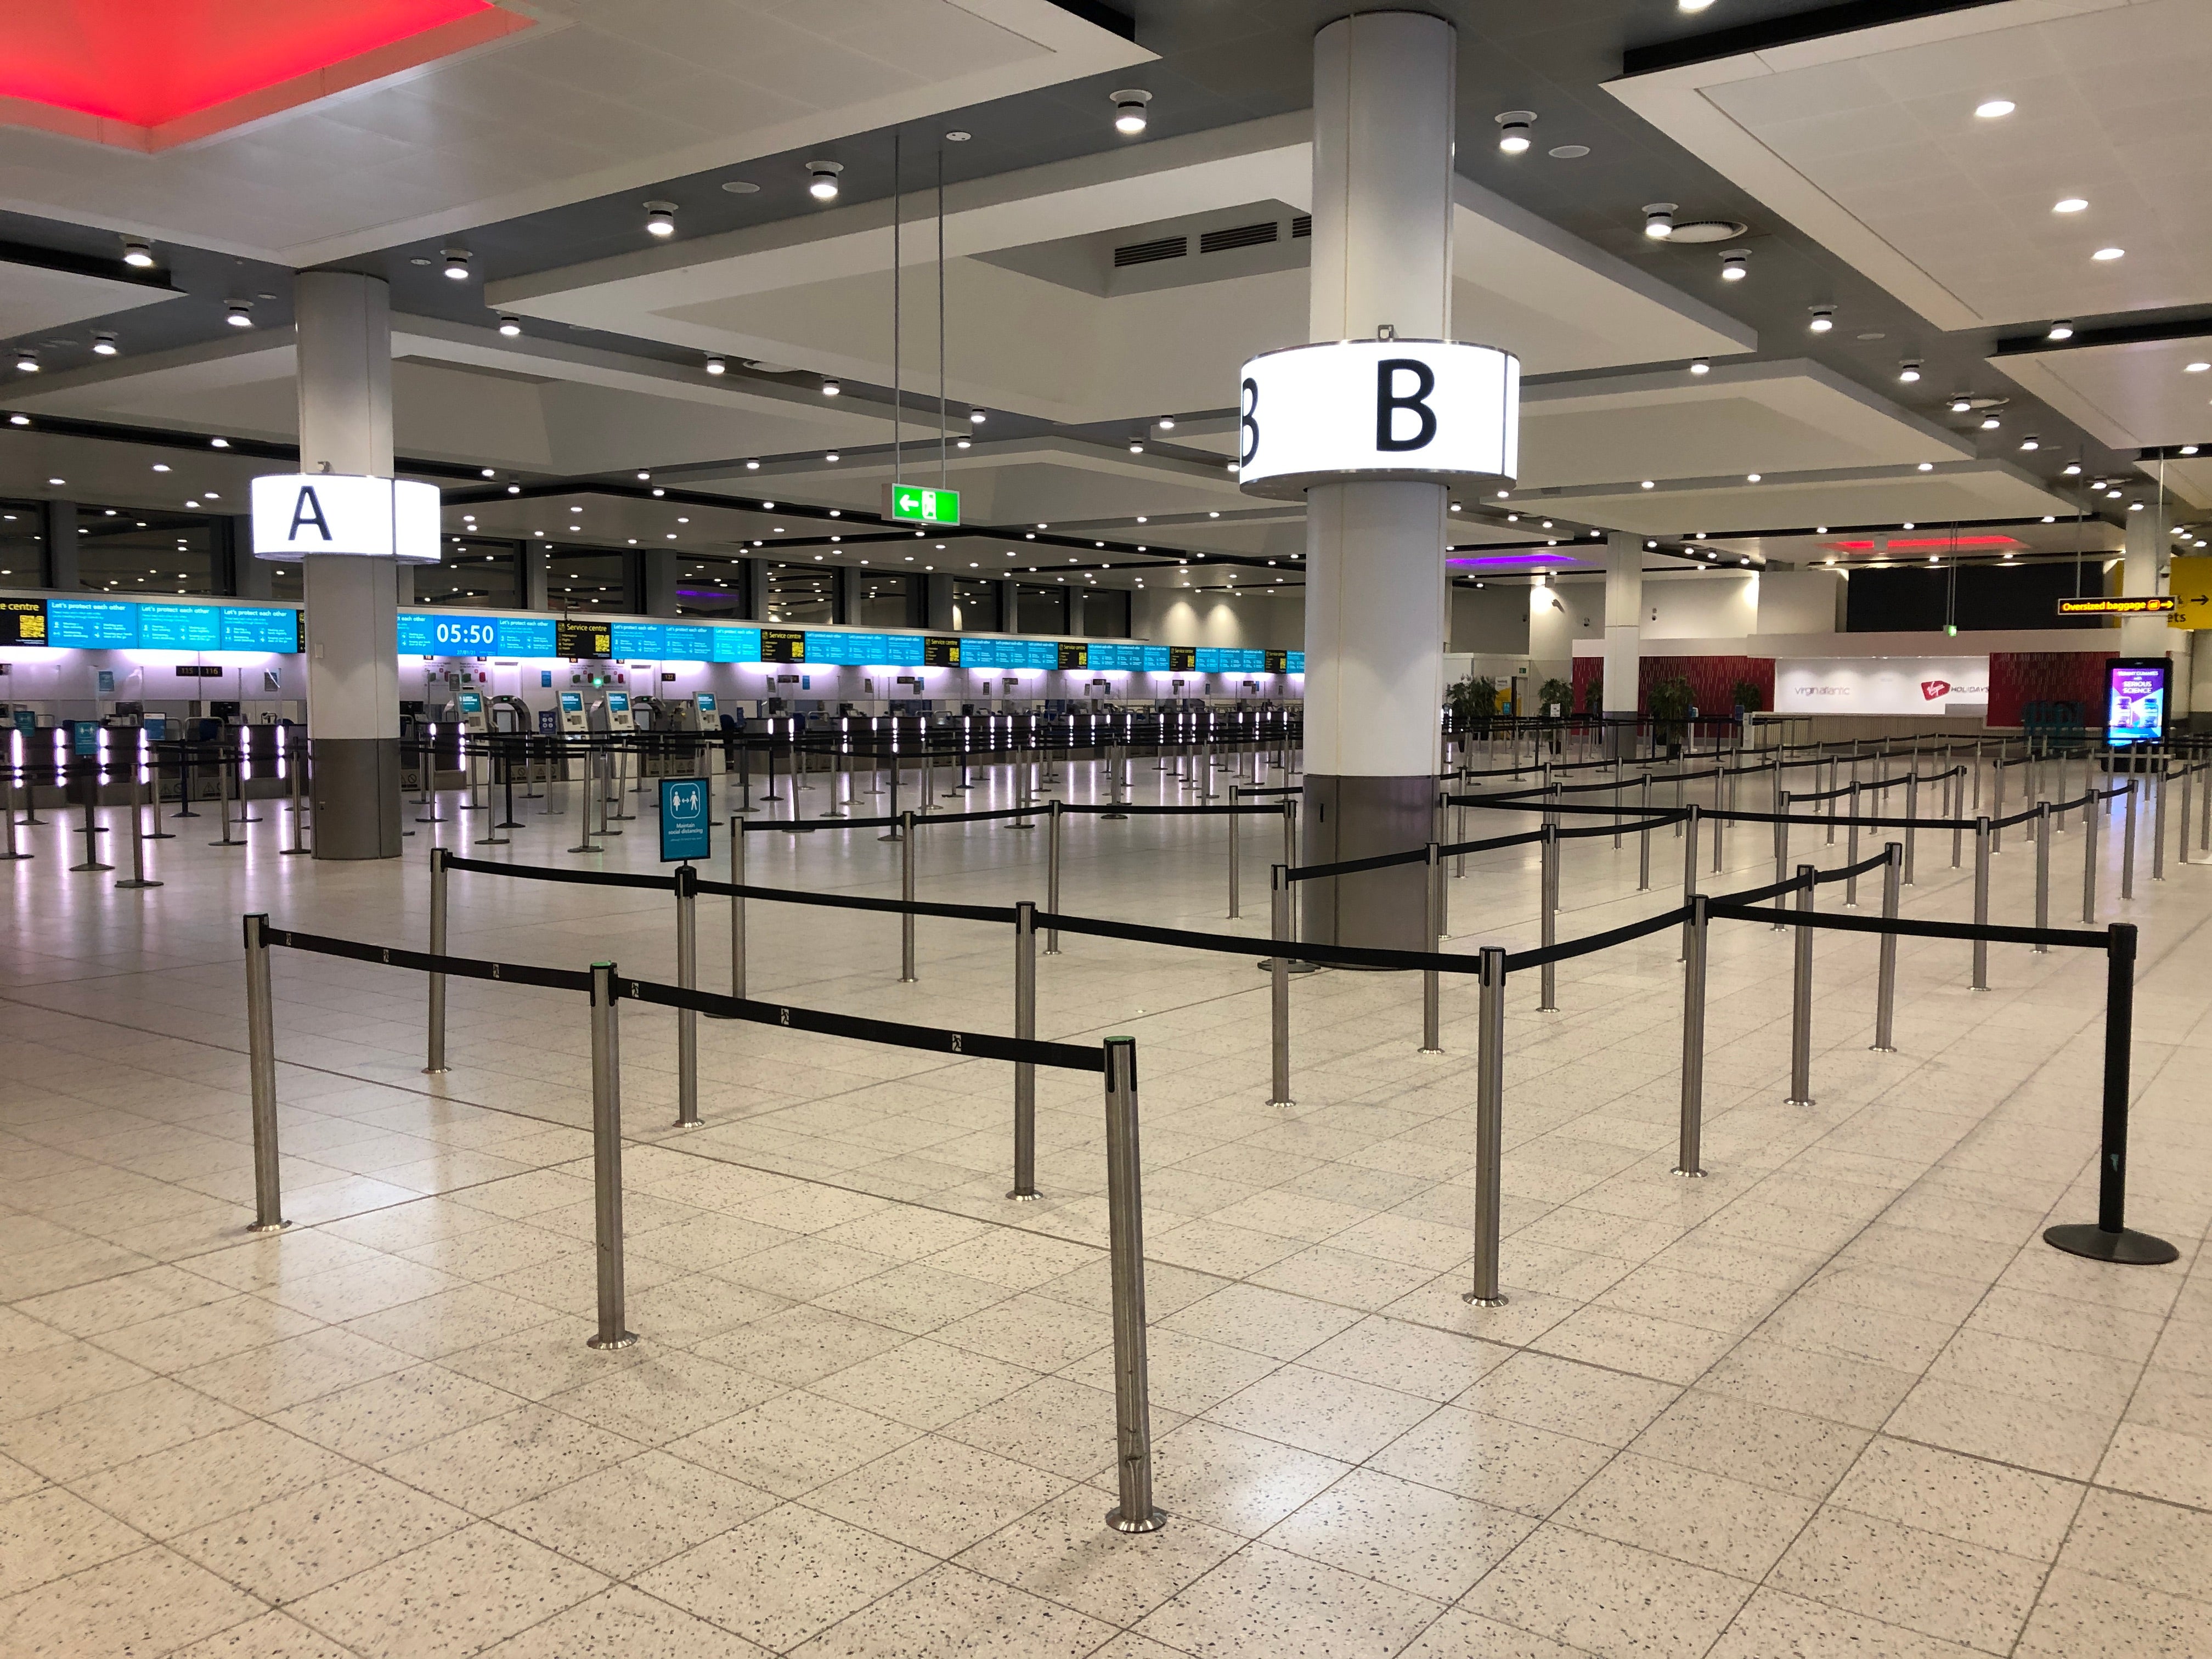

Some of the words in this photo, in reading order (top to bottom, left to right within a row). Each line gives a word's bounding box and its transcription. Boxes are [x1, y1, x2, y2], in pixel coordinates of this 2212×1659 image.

[1376, 358, 1437, 452] B
[288, 486, 333, 540] A
[2063, 602, 2105, 611] Oversized
[2106, 601, 2146, 611] baggage
[437, 623, 494, 644] 05:50
